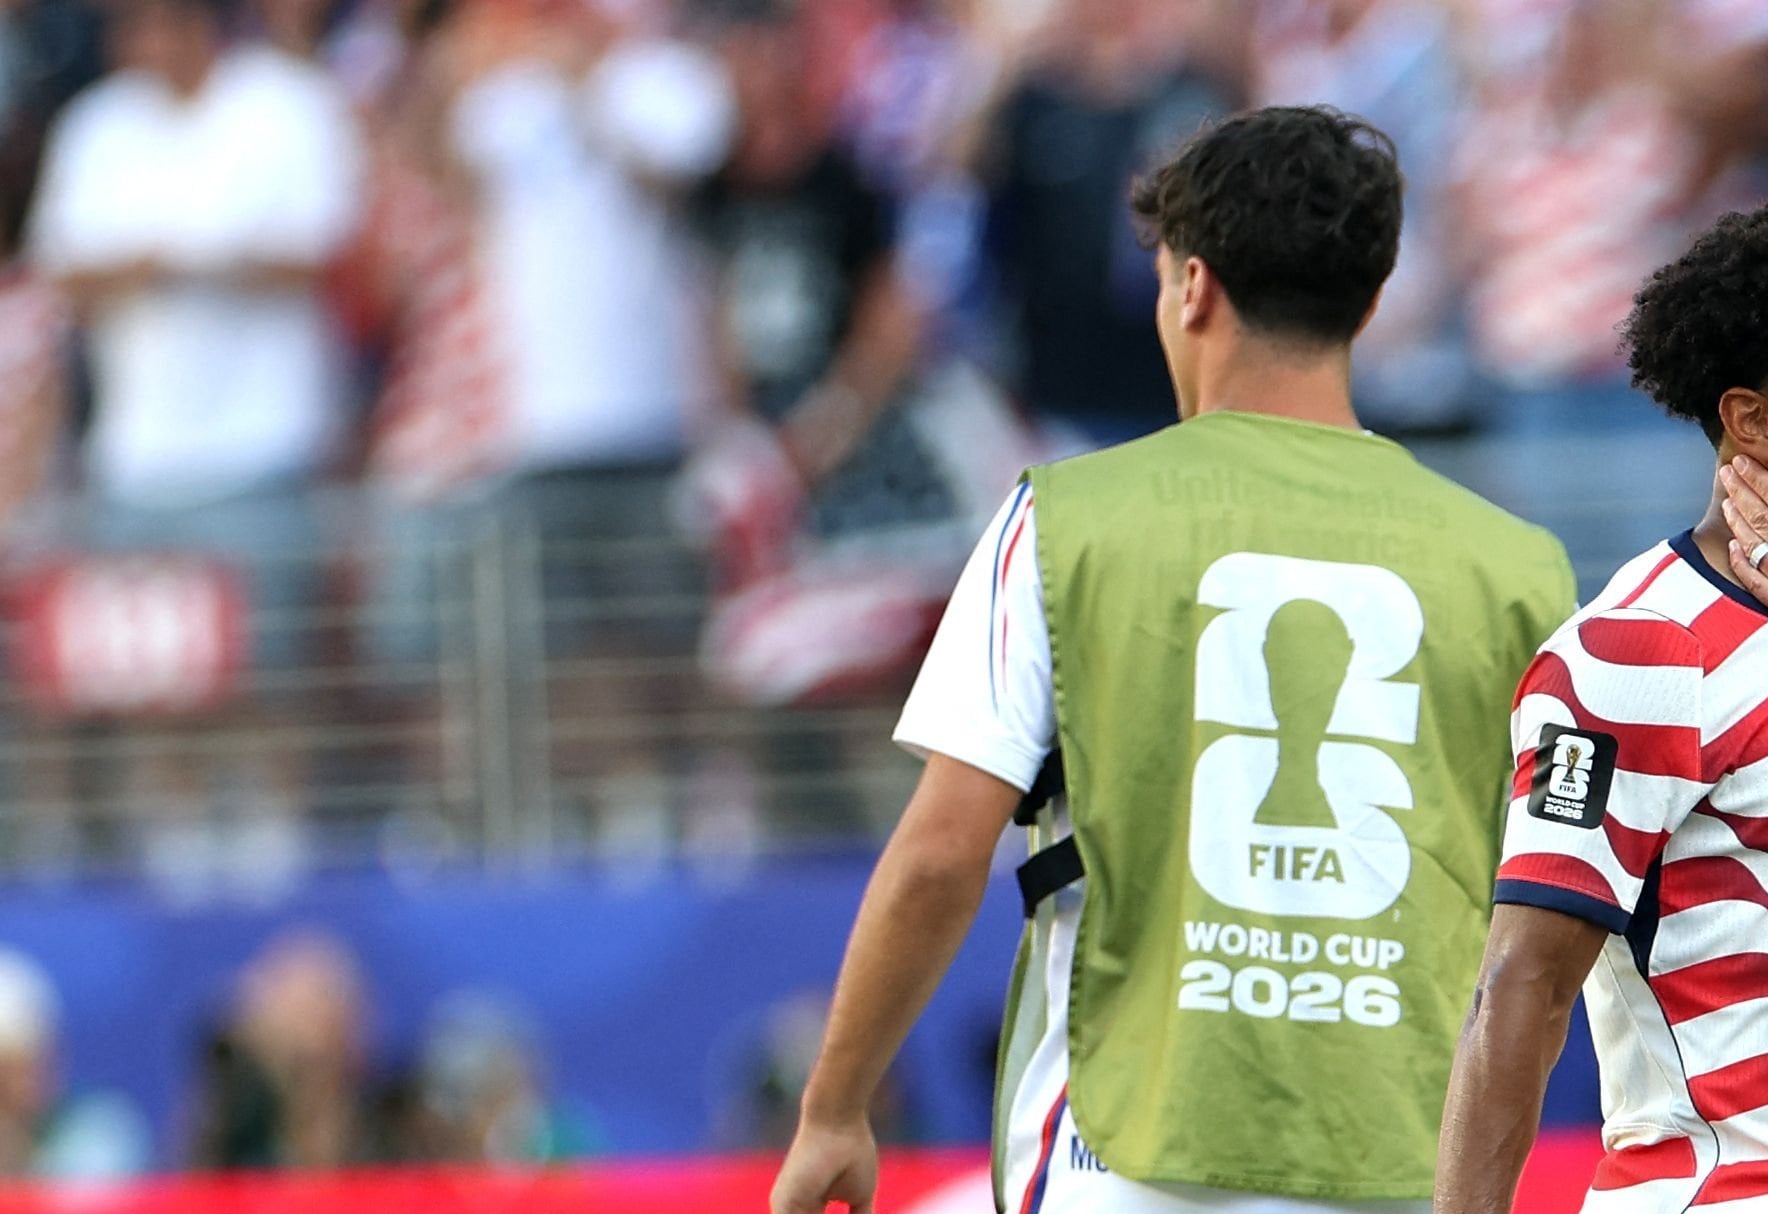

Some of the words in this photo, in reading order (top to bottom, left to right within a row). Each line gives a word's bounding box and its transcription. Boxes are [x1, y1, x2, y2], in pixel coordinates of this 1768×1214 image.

[1543, 803, 1584, 820] 2026
[1248, 843, 1347, 884] FIFA
[1183, 920, 1320, 964] WORLD
[1324, 932, 1405, 970] CUP
[1178, 958, 1402, 1028] 2026
